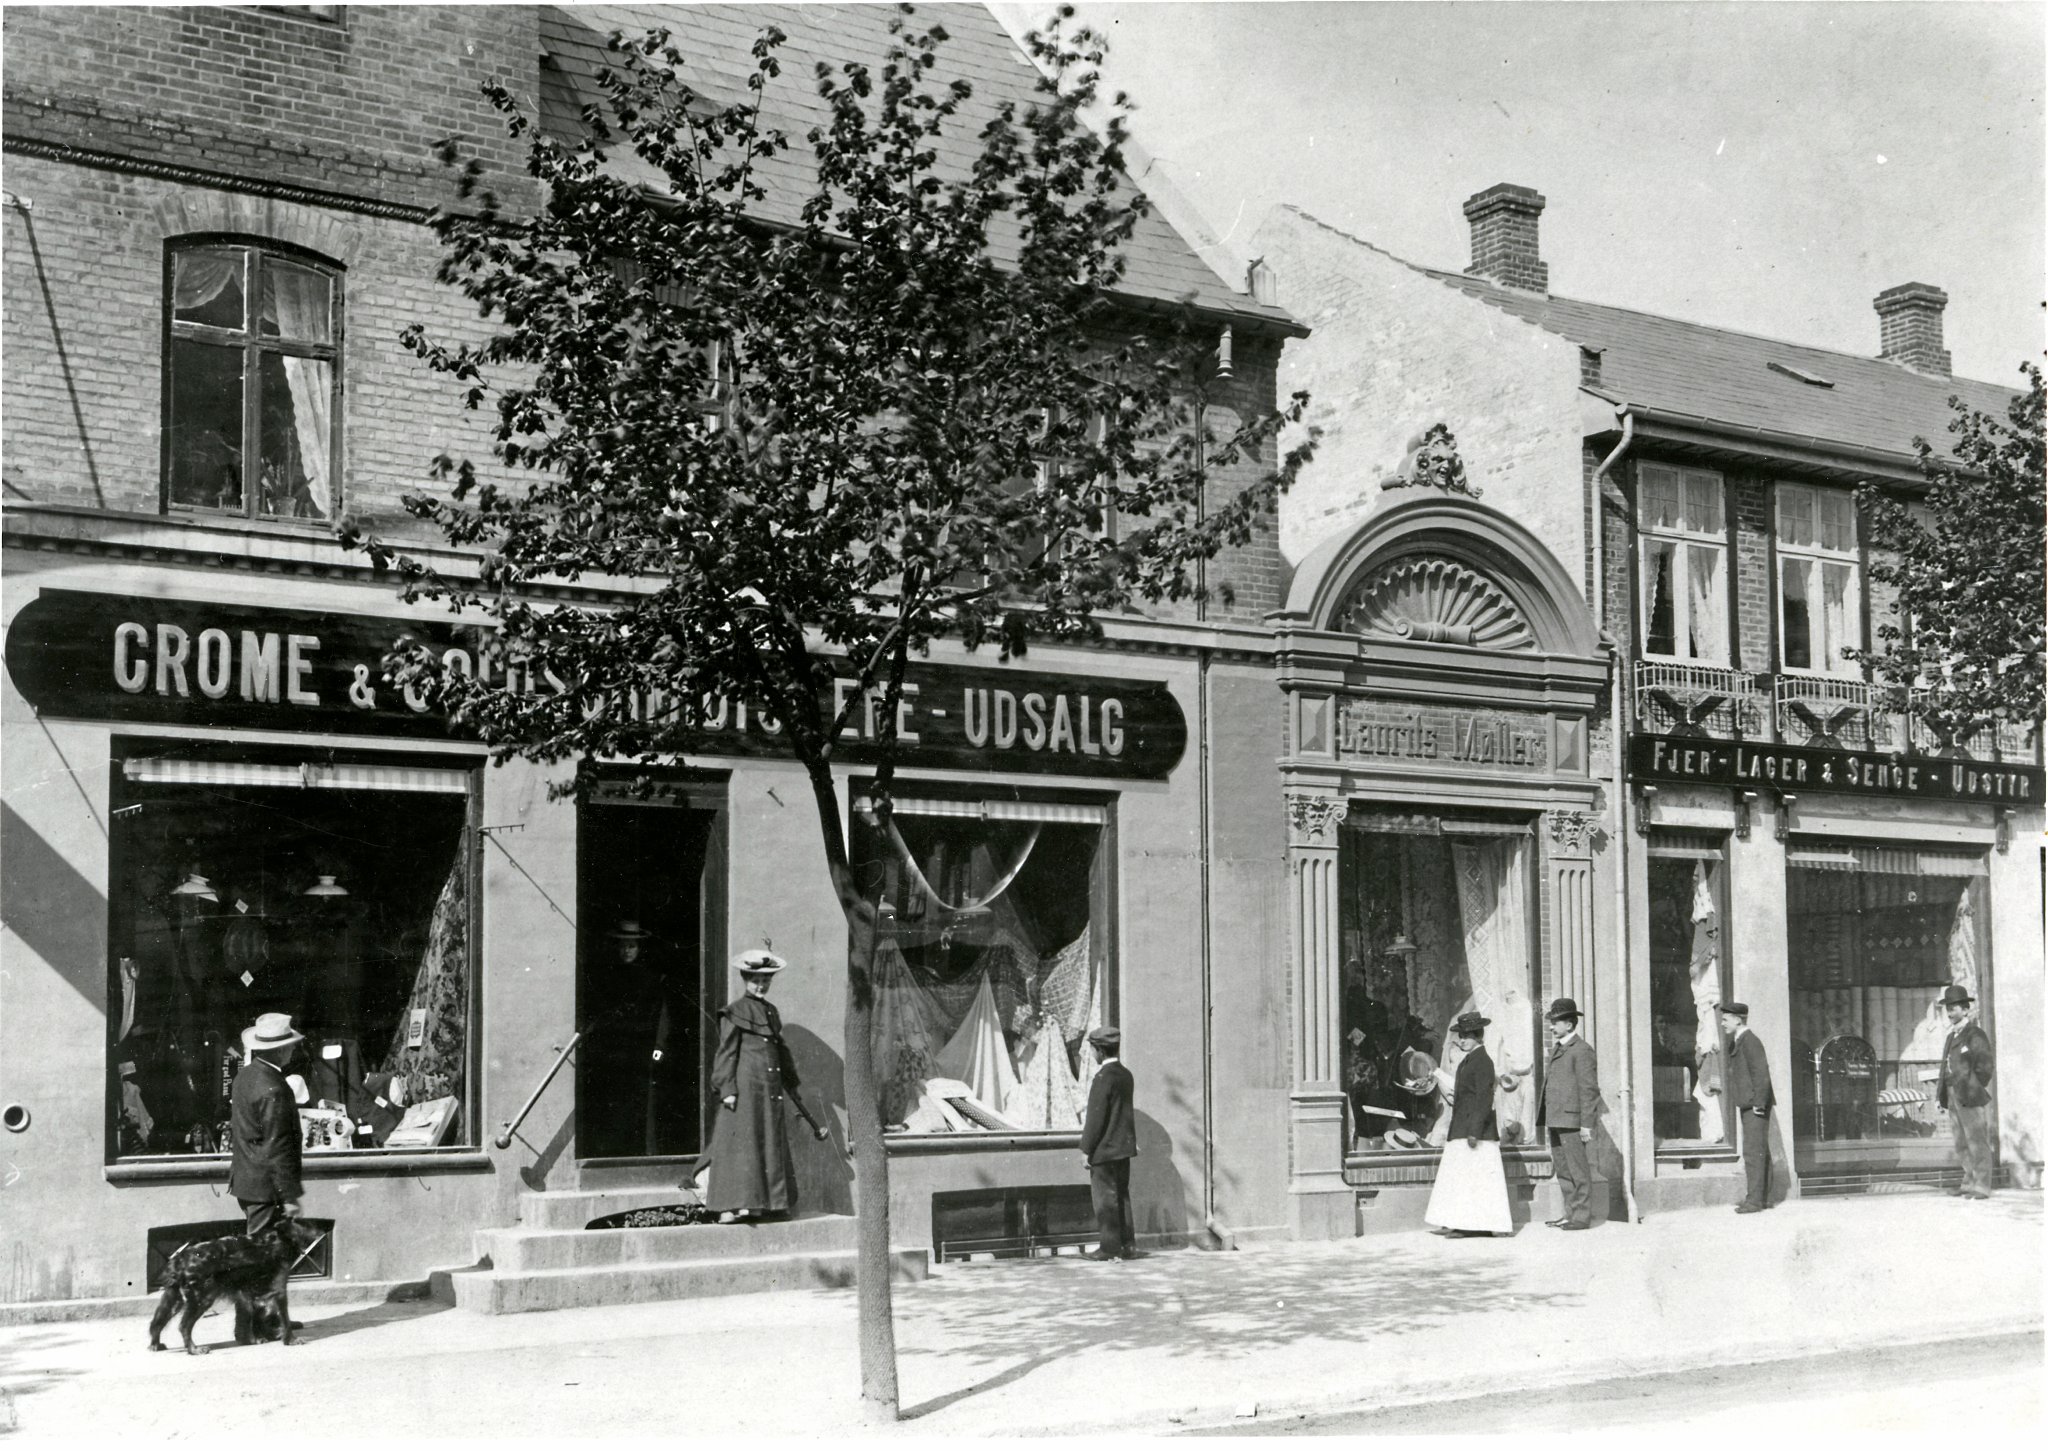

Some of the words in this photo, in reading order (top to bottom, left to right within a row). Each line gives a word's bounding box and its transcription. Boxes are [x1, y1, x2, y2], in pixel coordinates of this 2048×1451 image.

[114, 620, 321, 705] CROME
[349, 662, 375, 709] &
[1821, 762, 1833, 783] &
